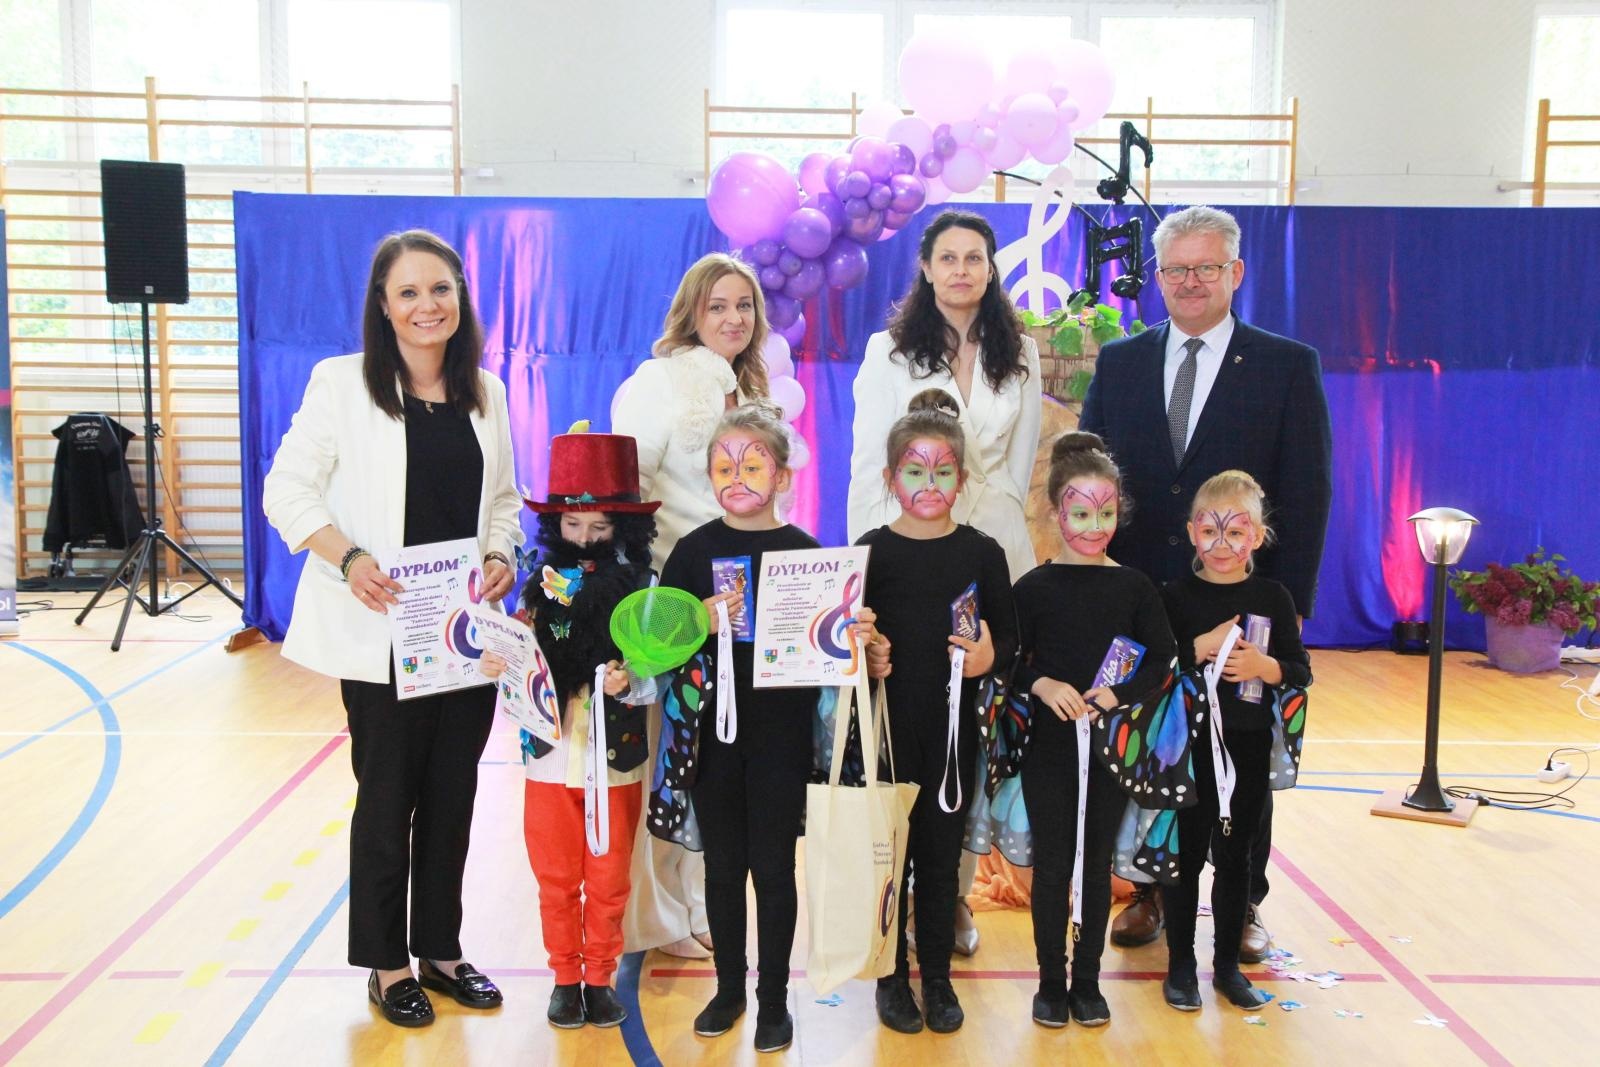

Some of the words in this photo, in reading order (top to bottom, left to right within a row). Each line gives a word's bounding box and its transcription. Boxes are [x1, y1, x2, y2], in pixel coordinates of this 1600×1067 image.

[390, 559, 459, 579] DYPLOM
[767, 561, 839, 577] DYPLOM
[474, 615, 525, 642] DYPLOM
